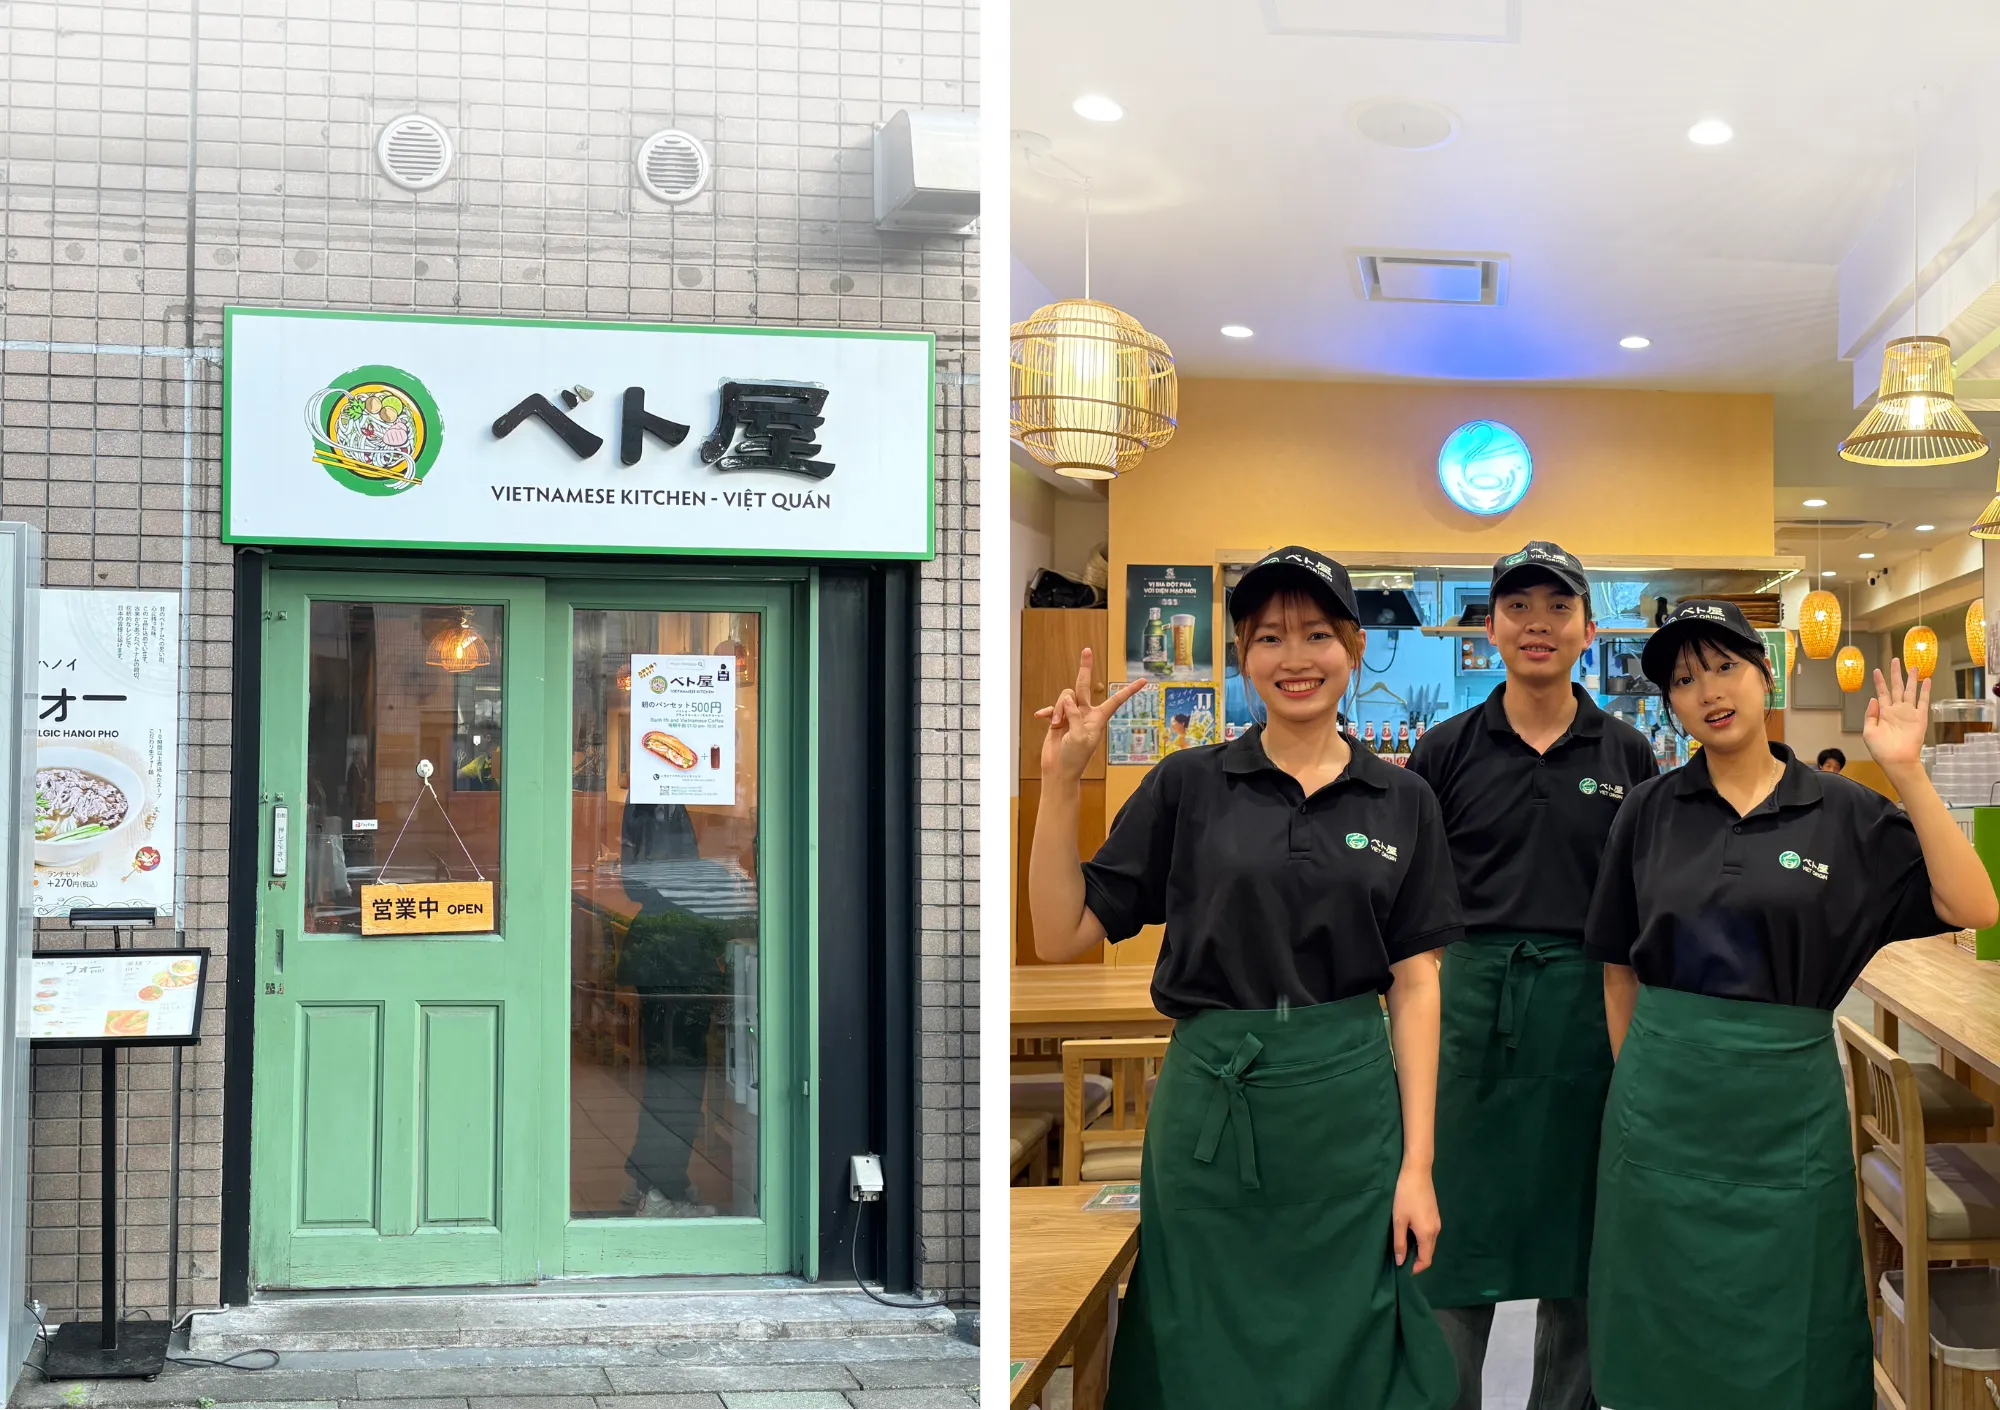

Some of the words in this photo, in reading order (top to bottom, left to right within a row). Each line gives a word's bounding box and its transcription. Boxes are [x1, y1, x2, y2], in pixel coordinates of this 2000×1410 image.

[491, 376, 836, 481] ベト屋
[491, 485, 615, 505] VIETNAMESE
[621, 489, 706, 507] KITCHEN
[722, 489, 767, 512] VIỆT
[771, 489, 830, 510] QUÁN
[1285, 554, 1333, 577] ベト屋
[1680, 606, 1725, 617] ベト屋
[670, 675, 714, 688] ベト屋
[63, 730, 96, 738] HANOI
[98, 730, 119, 738] PHO
[372, 896, 439, 921] 営業中
[447, 903, 483, 915] OPEN
